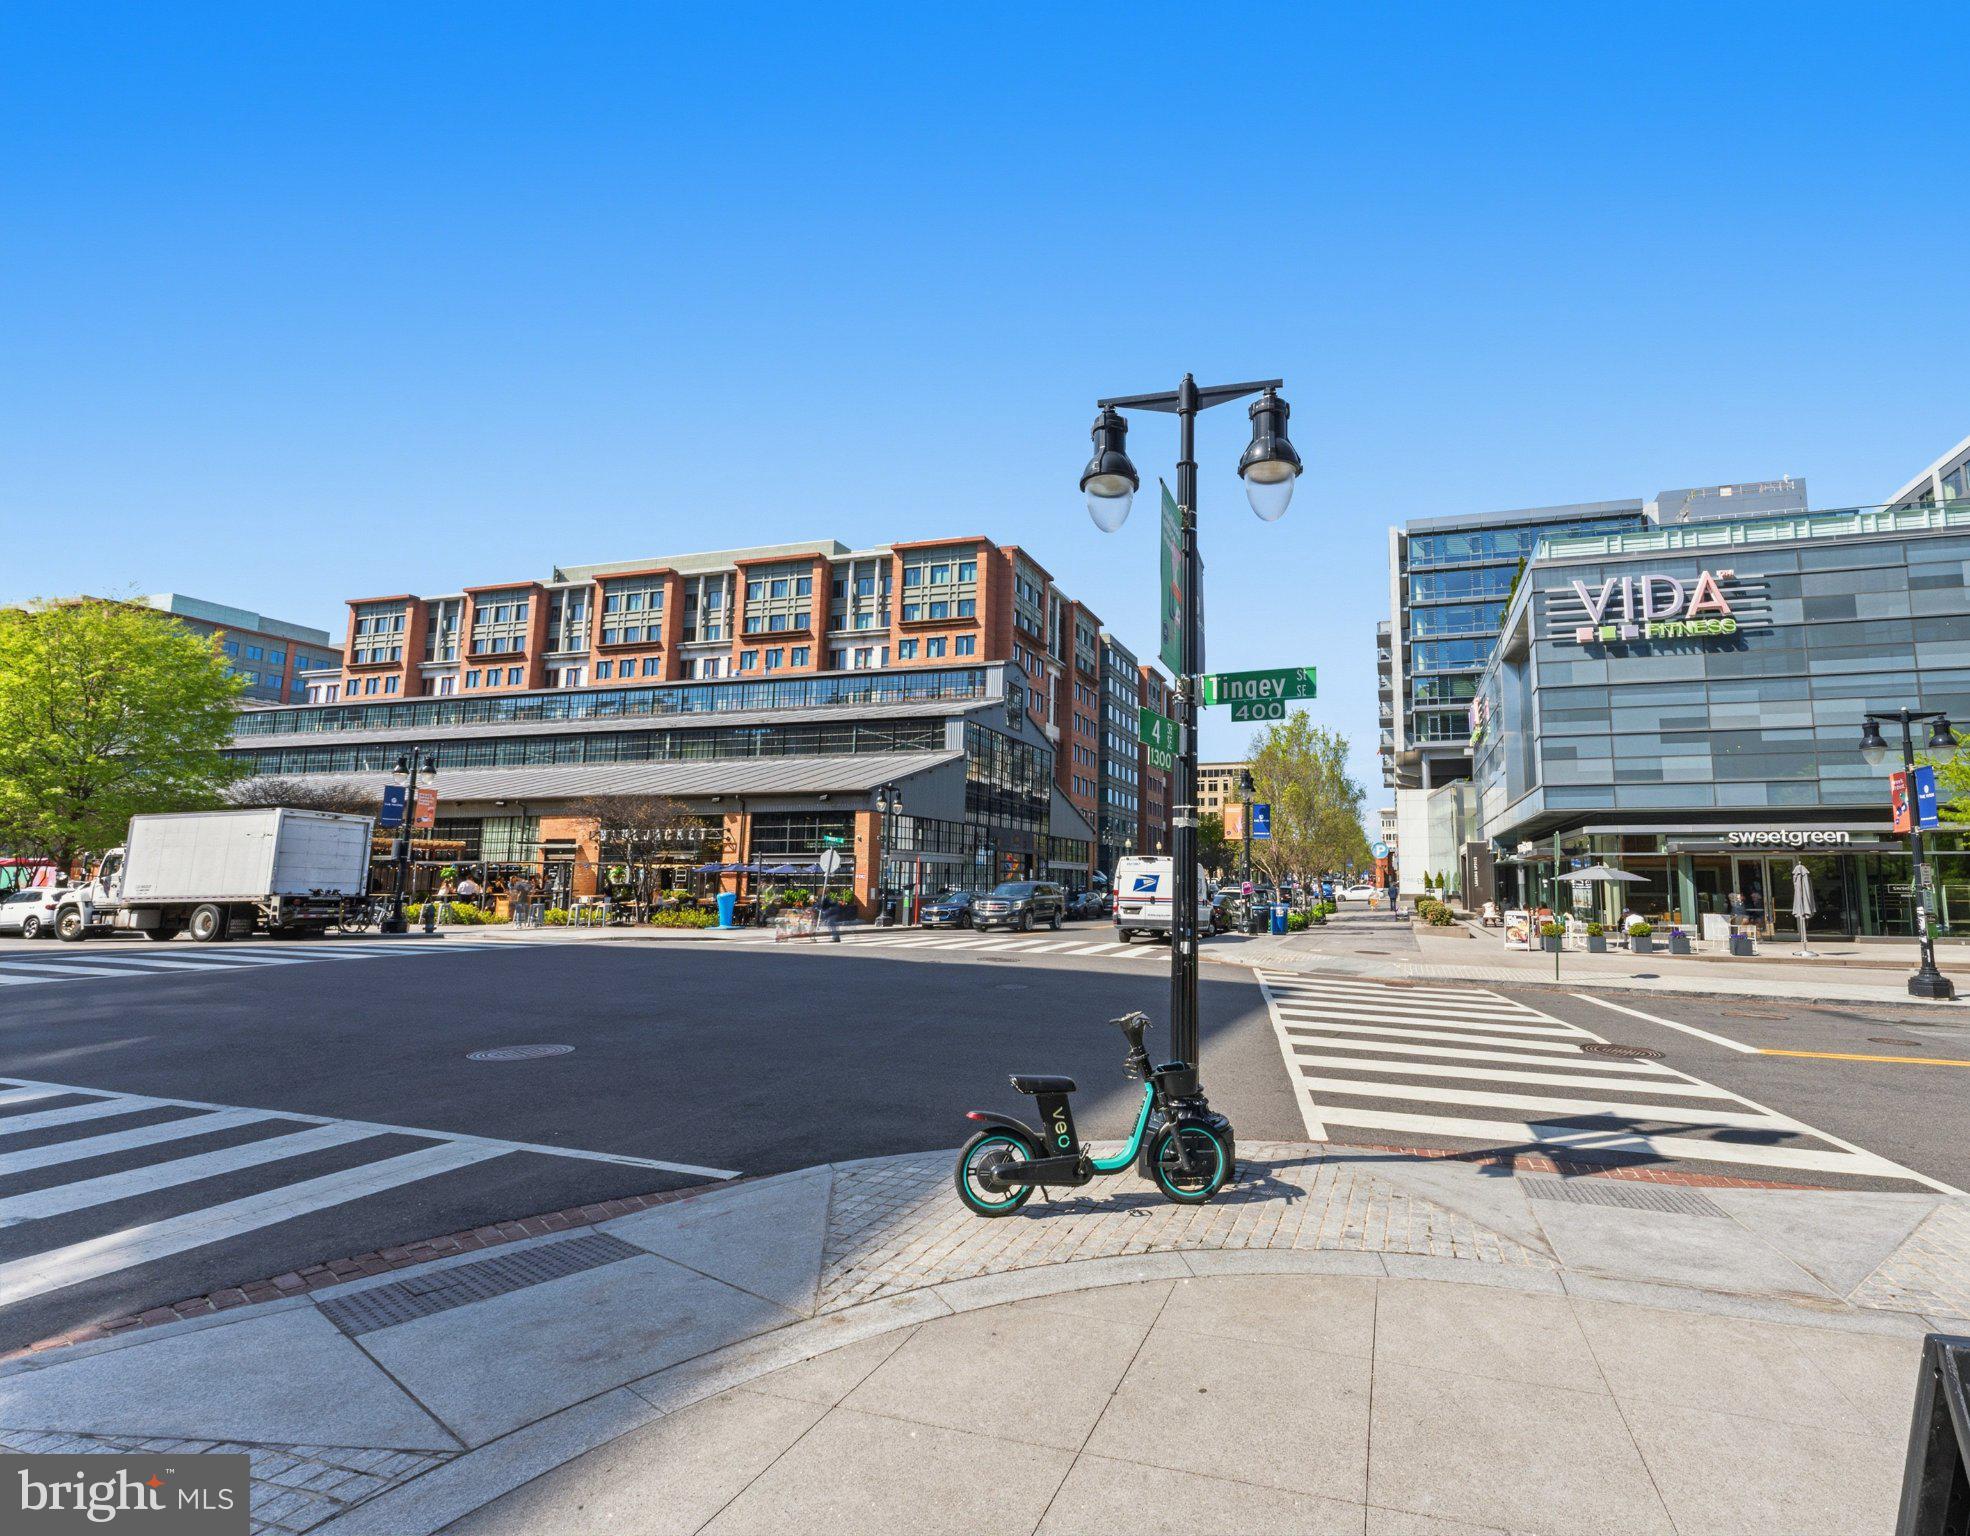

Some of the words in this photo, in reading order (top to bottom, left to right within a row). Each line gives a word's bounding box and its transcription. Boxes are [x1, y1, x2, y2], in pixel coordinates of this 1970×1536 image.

[1572, 570, 1732, 623] VIDA
[1646, 618, 1737, 639] FITNESS
[1209, 677, 1286, 700] Tingey
[1297, 684, 1307, 697] SE
[1235, 702, 1282, 720] 400
[1151, 719, 1161, 744] 4
[1151, 748, 1172, 769] 1300
[1728, 829, 1850, 846] sweetgreen
[1375, 845, 1386, 856] P
[1052, 1106, 1070, 1148] veo
